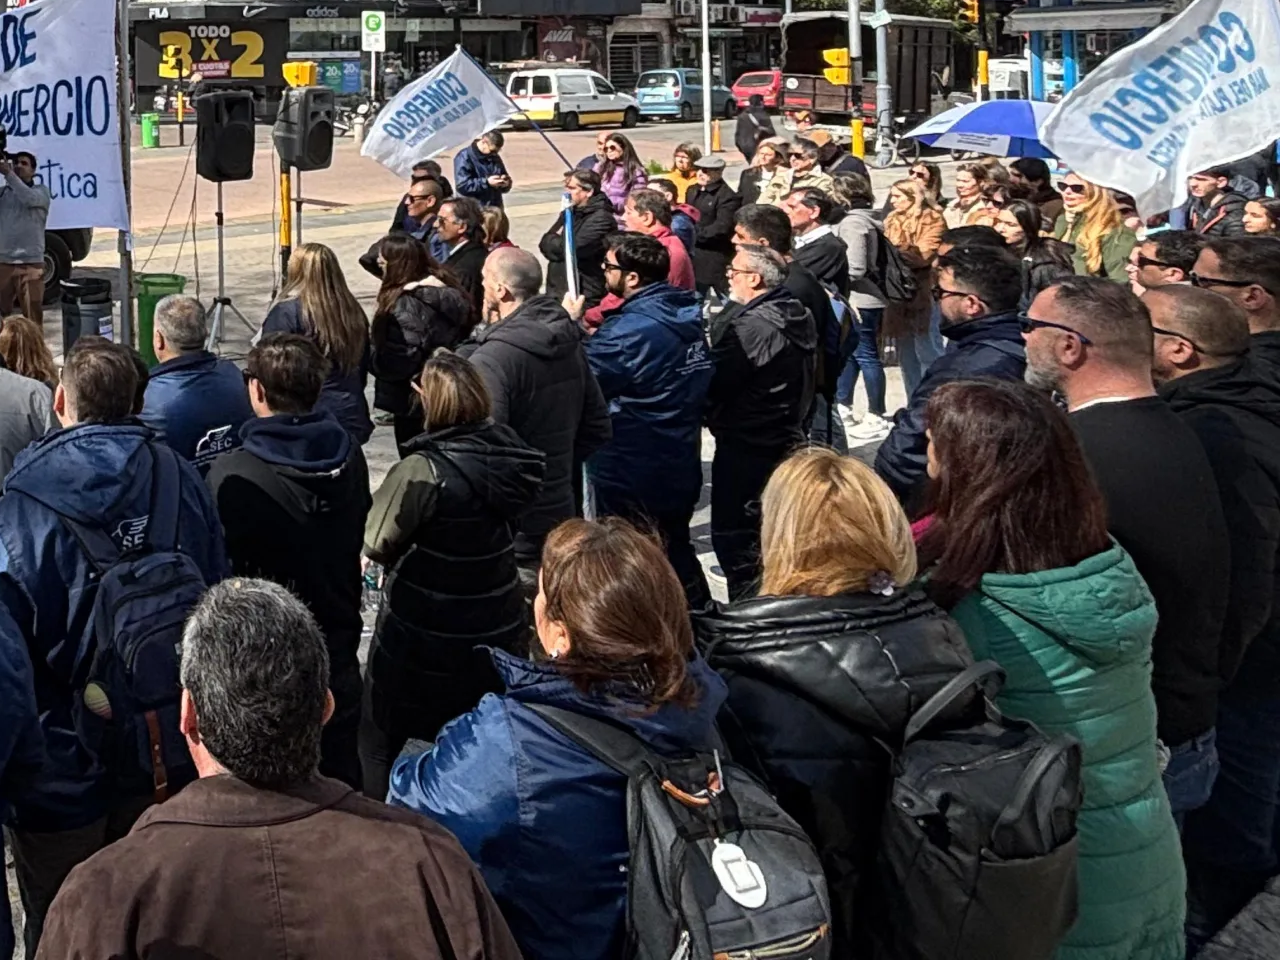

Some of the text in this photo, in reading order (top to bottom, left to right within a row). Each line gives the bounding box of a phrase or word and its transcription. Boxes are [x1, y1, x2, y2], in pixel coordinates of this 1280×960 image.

[149, 7, 169, 19] FILA
[306, 6, 339, 18] adidas
[188, 25, 231, 38] TODO
[0, 8, 42, 73] DE
[209, 436, 233, 452] SEC
[122, 533, 145, 550] SE
